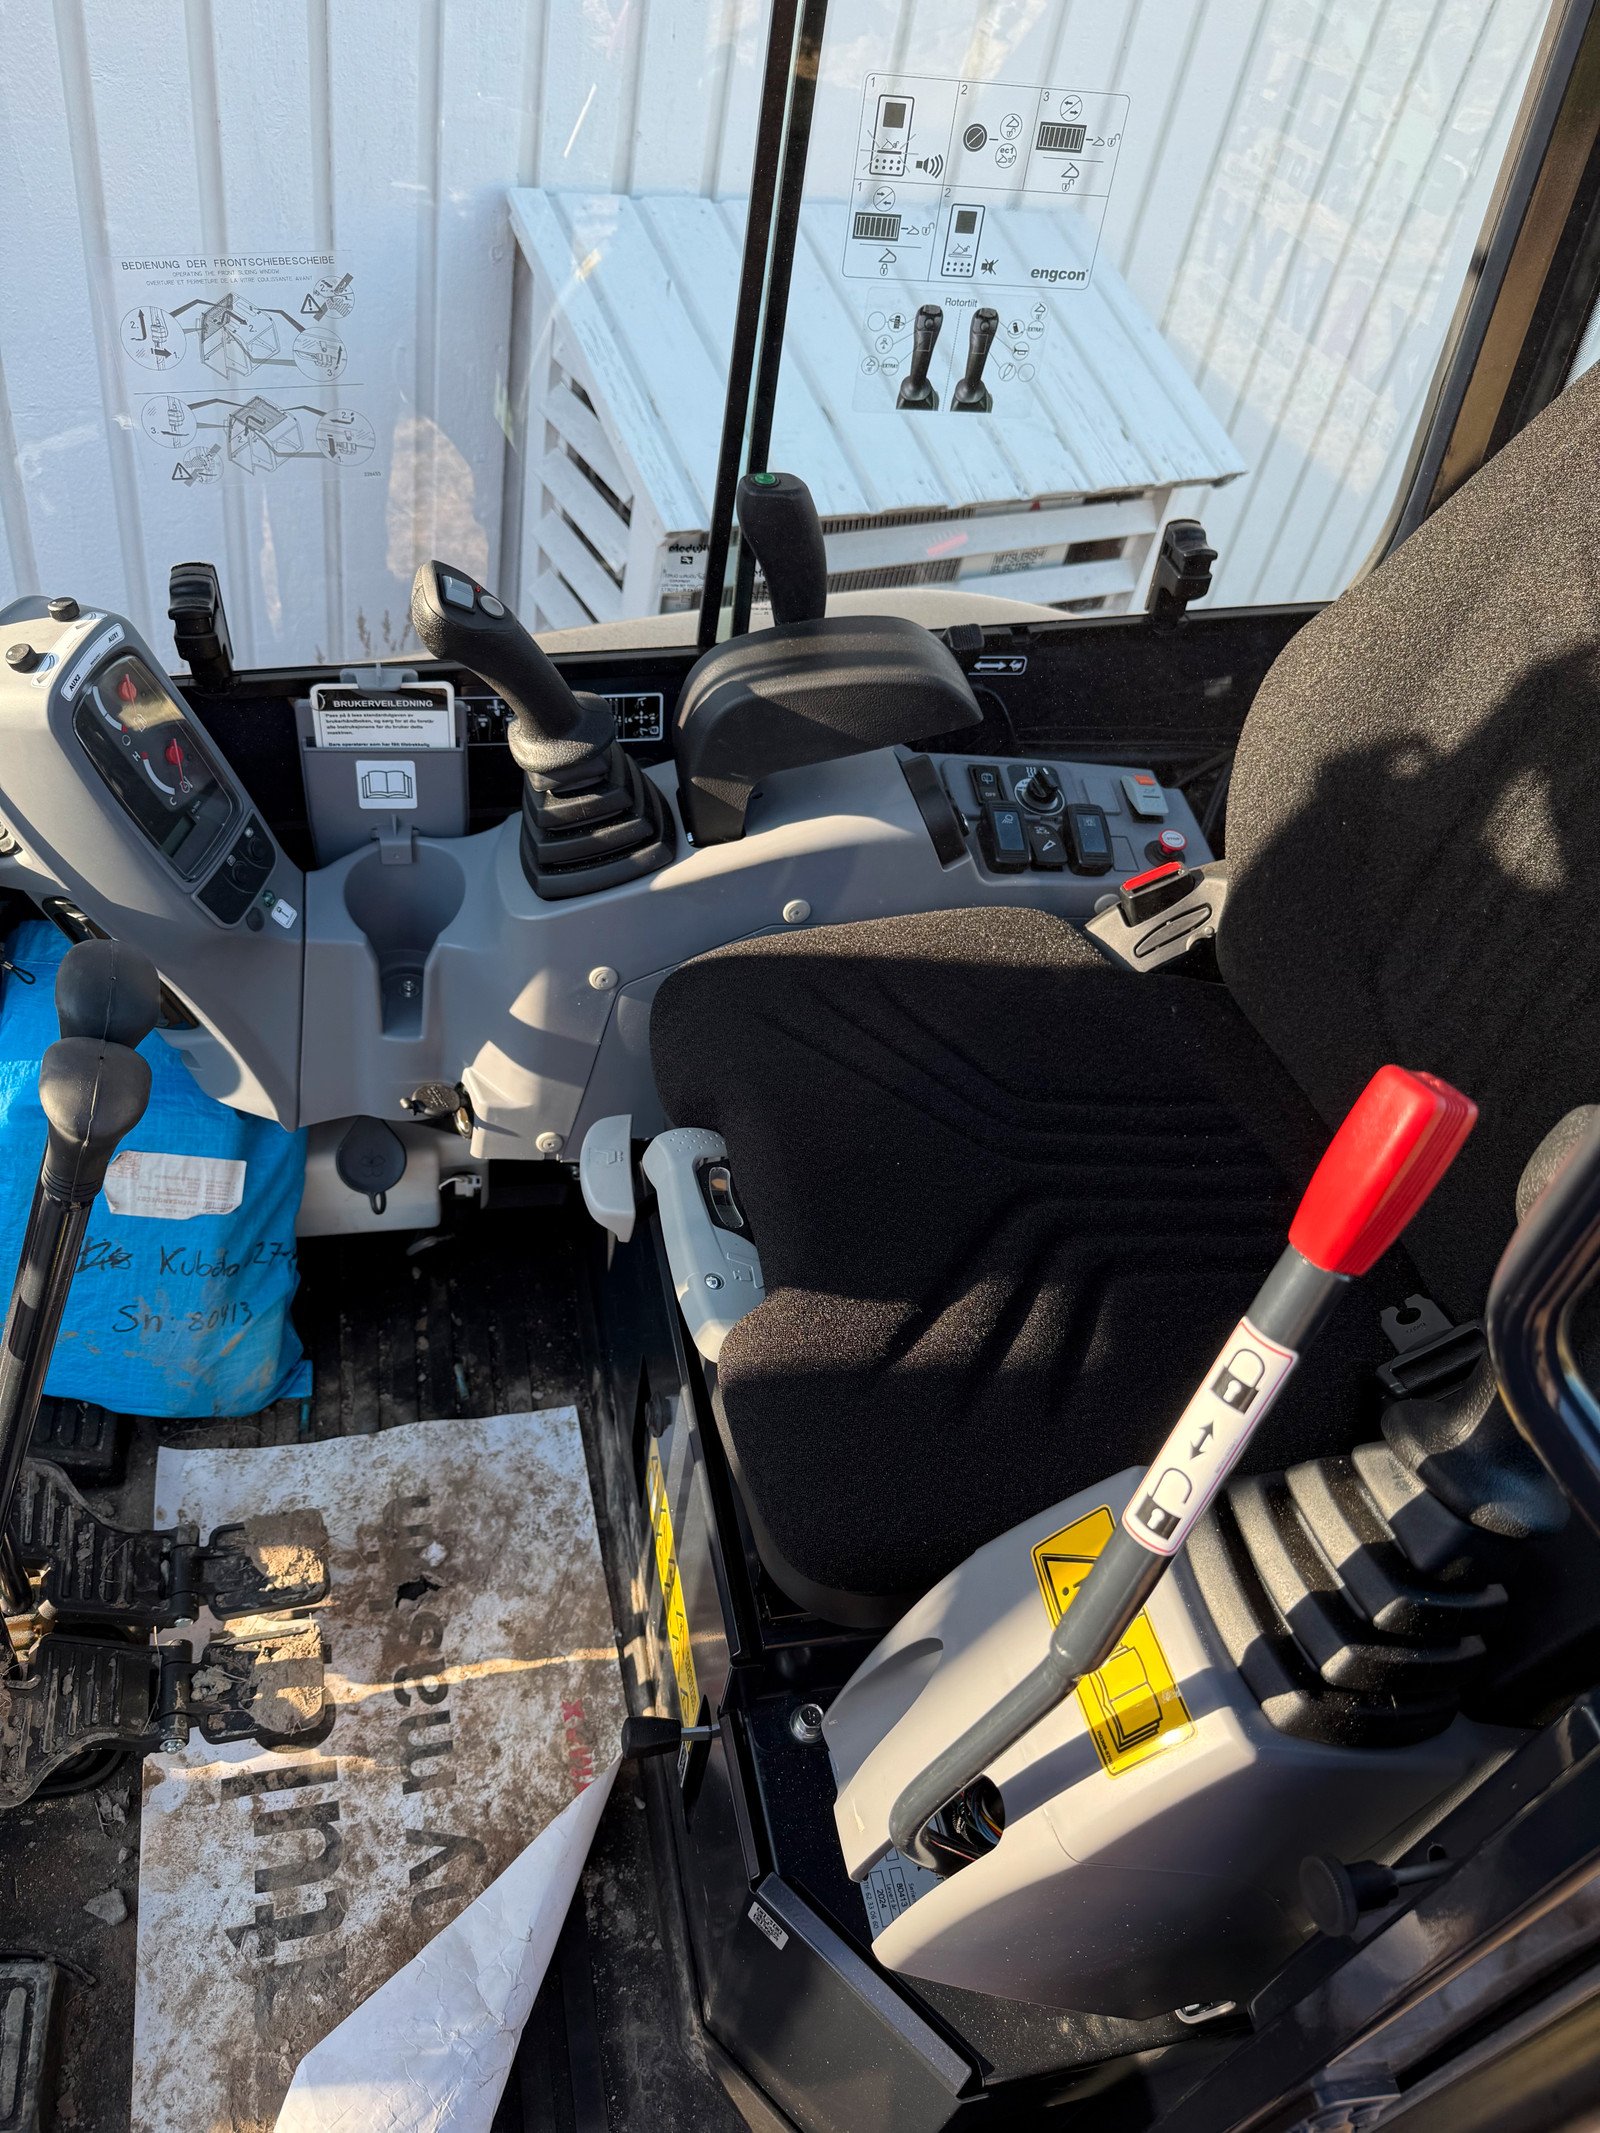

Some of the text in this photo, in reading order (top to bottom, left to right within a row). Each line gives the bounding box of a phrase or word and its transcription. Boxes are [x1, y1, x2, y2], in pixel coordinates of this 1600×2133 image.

[870, 77, 876, 88] 1
[961, 84, 968, 95] 2
[1043, 91, 1050, 102] 3
[857, 181, 863, 192] 1
[944, 188, 951, 198] 2
[121, 255, 335, 270] BEDIENUNG DER FRONTSCHIEBESCHEIBE
[1030, 267, 1087, 284] engcon
[945, 297, 978, 308] Rotortilt
[108, 631, 119, 643] AUX1
[69, 673, 81, 692] AUX2
[333, 700, 434, 708] BRUKERVEILEDNING
[877, 1889, 887, 1909] 2024
[896, 1882, 908, 1907] 80413
